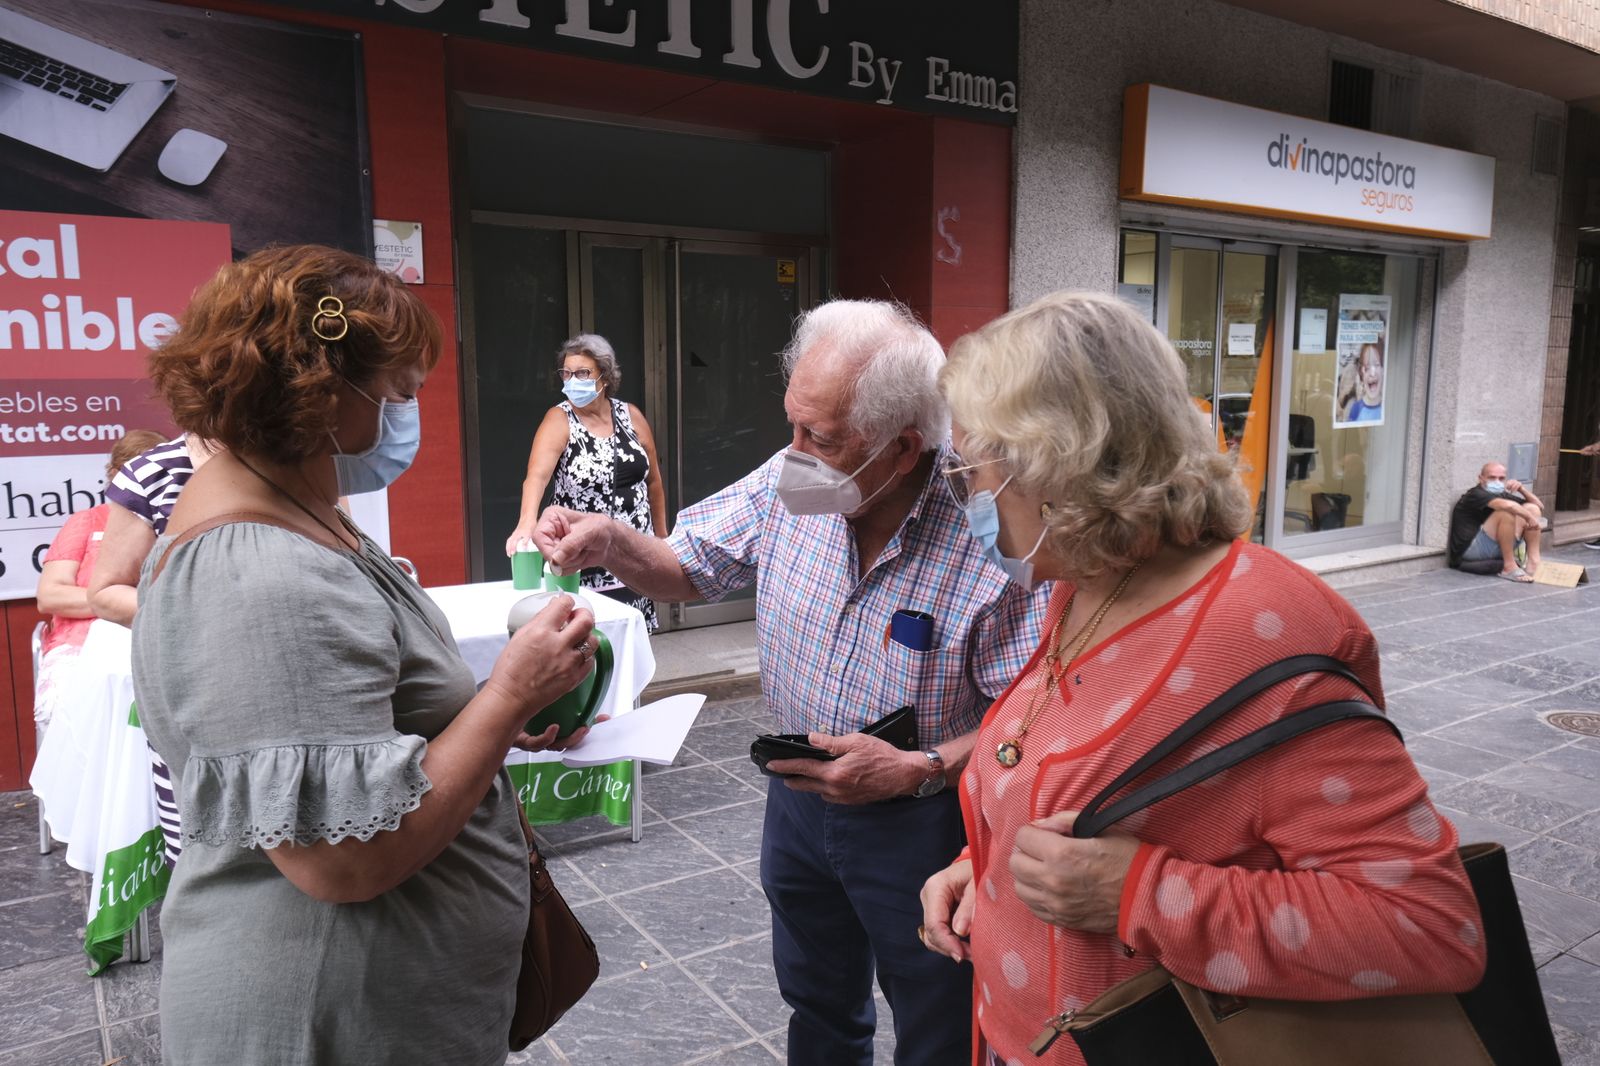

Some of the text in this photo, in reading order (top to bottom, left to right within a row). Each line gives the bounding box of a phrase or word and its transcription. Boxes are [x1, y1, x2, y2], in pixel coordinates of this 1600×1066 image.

[848, 41, 902, 105] By
[925, 56, 1018, 113] Emma
[1267, 133, 1416, 189] divinapastora
[1361, 188, 1414, 214] seguros
[86, 395, 121, 412] en
[518, 767, 631, 804] el Cáner
